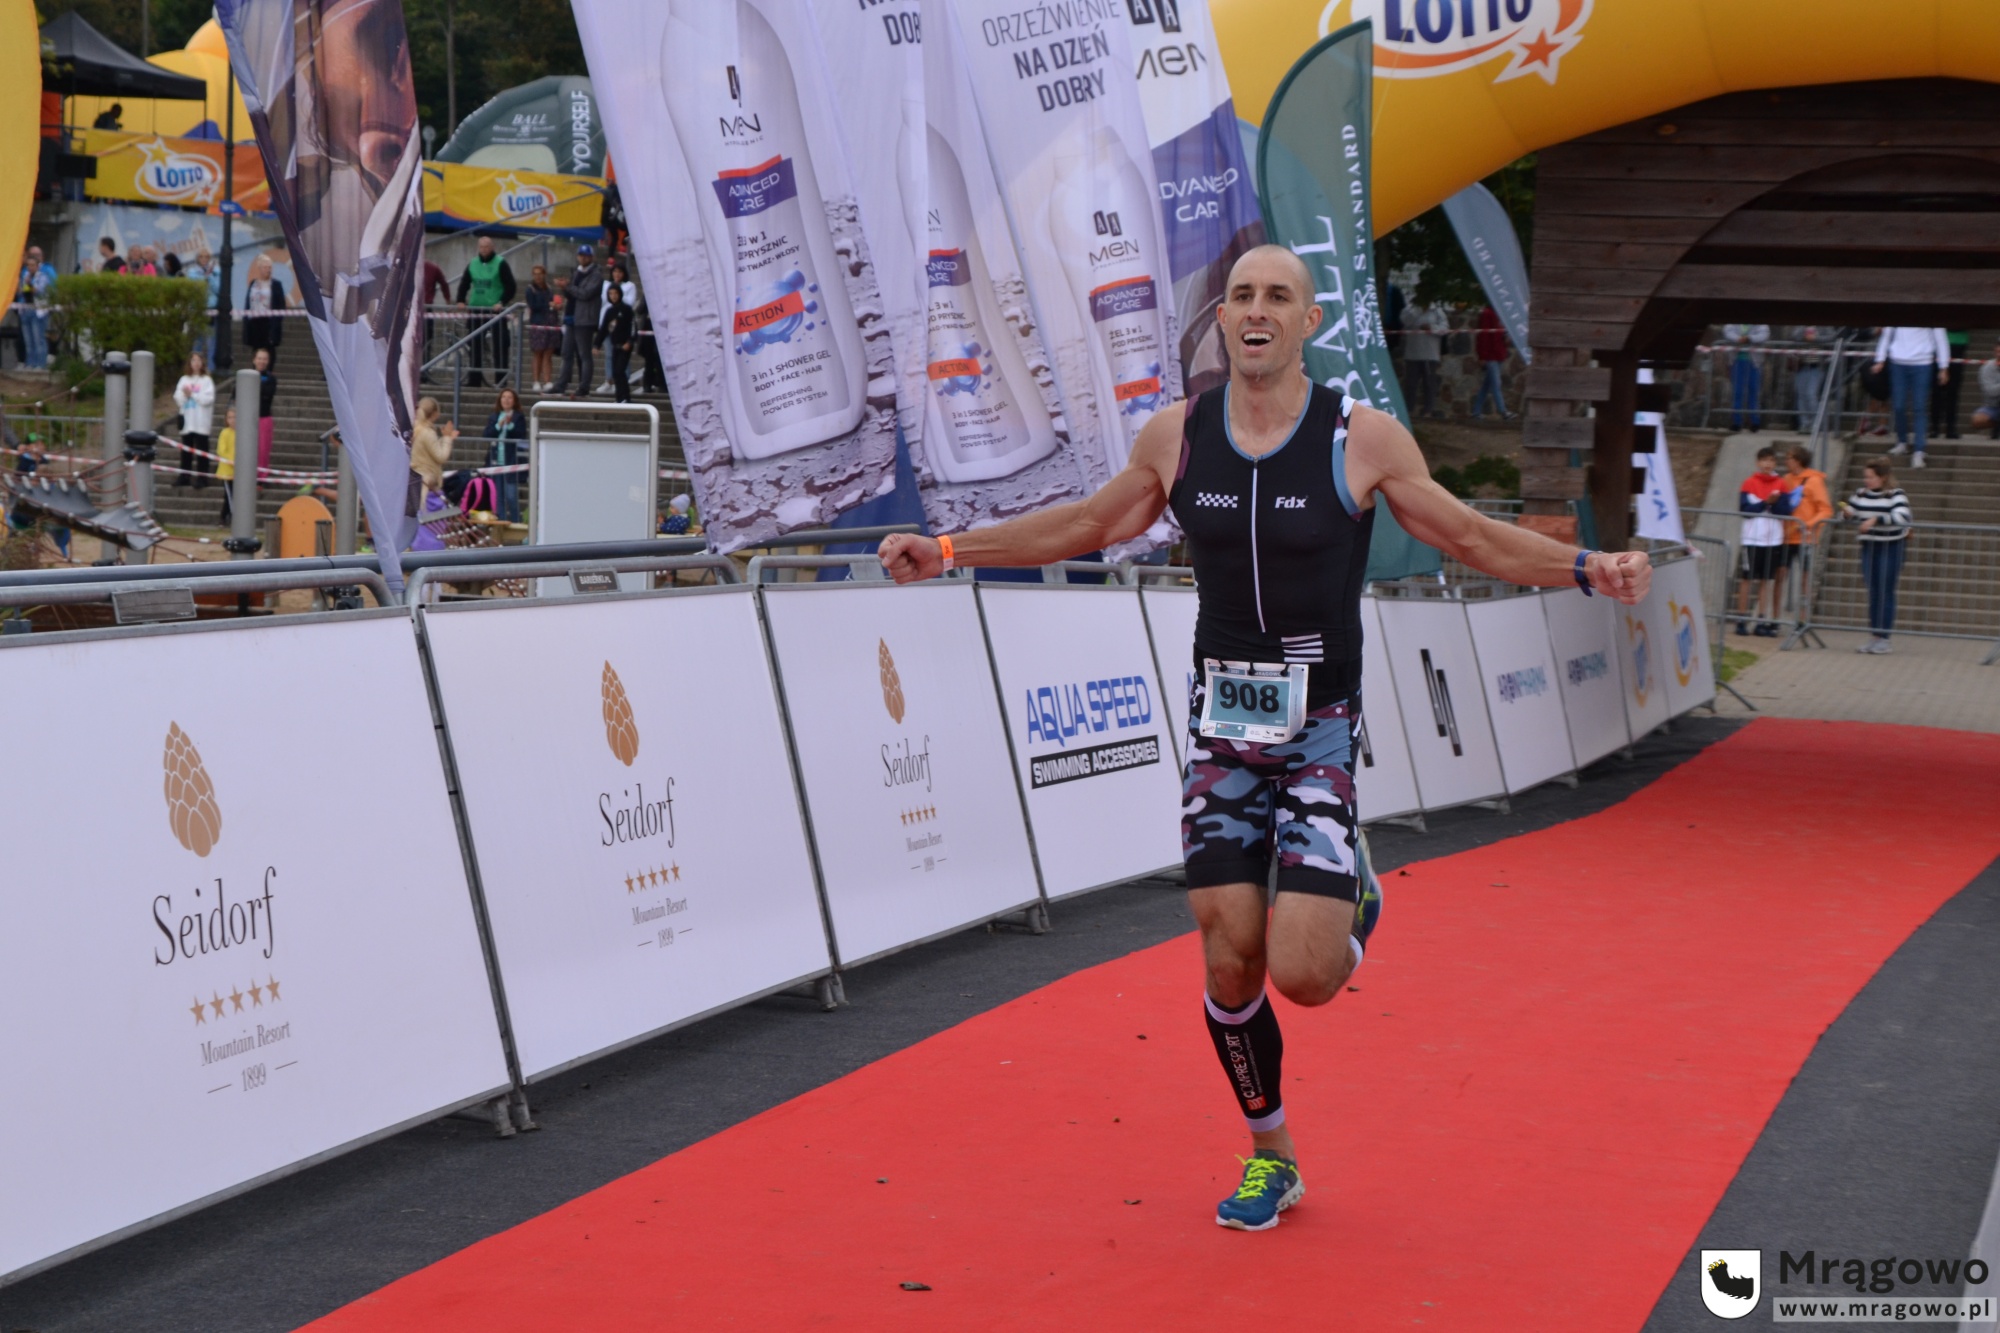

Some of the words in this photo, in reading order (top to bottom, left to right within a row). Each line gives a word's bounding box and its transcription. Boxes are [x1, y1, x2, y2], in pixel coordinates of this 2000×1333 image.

[1013, 47, 1049, 79] NA
[1037, 68, 1105, 112] DOBRY
[571, 90, 591, 174] YOURSELF
[155, 166, 203, 188] LOTTO
[508, 194, 543, 212] LOTTO
[1342, 124, 1367, 271] STANDARD
[1096, 286, 1151, 307] ADVANCED
[1113, 298, 1142, 311] CARE
[739, 303, 785, 328] ACTION
[751, 374, 758, 382] 3
[759, 371, 768, 380] in
[768, 368, 774, 376] 1
[775, 353, 815, 373] SHOWER
[816, 349, 832, 360] GEL
[754, 380, 776, 393] BODY
[780, 370, 801, 383] FACE
[805, 364, 824, 375] HAIR
[938, 362, 970, 375] ACTION
[759, 385, 813, 409] REFRESHING
[762, 400, 795, 417] POWER
[795, 390, 829, 405] SYSTEM
[1122, 382, 1152, 396] ACTION
[993, 401, 1008, 411] GEL
[1275, 497, 1306, 508] Fdx
[1219, 680, 1280, 713] 908
[1026, 685, 1091, 748] AQUA
[1086, 675, 1152, 733] SPEED
[880, 734, 932, 793] Seidorf
[1033, 756, 1090, 785] SWIMMING
[1092, 740, 1159, 773] ACCESSORIES
[598, 776, 675, 849] Seidorf
[152, 866, 277, 967] Seidorf
[200, 1030, 256, 1067] Mountain
[256, 1022, 292, 1052] Resort
[241, 1063, 268, 1092] 1899
